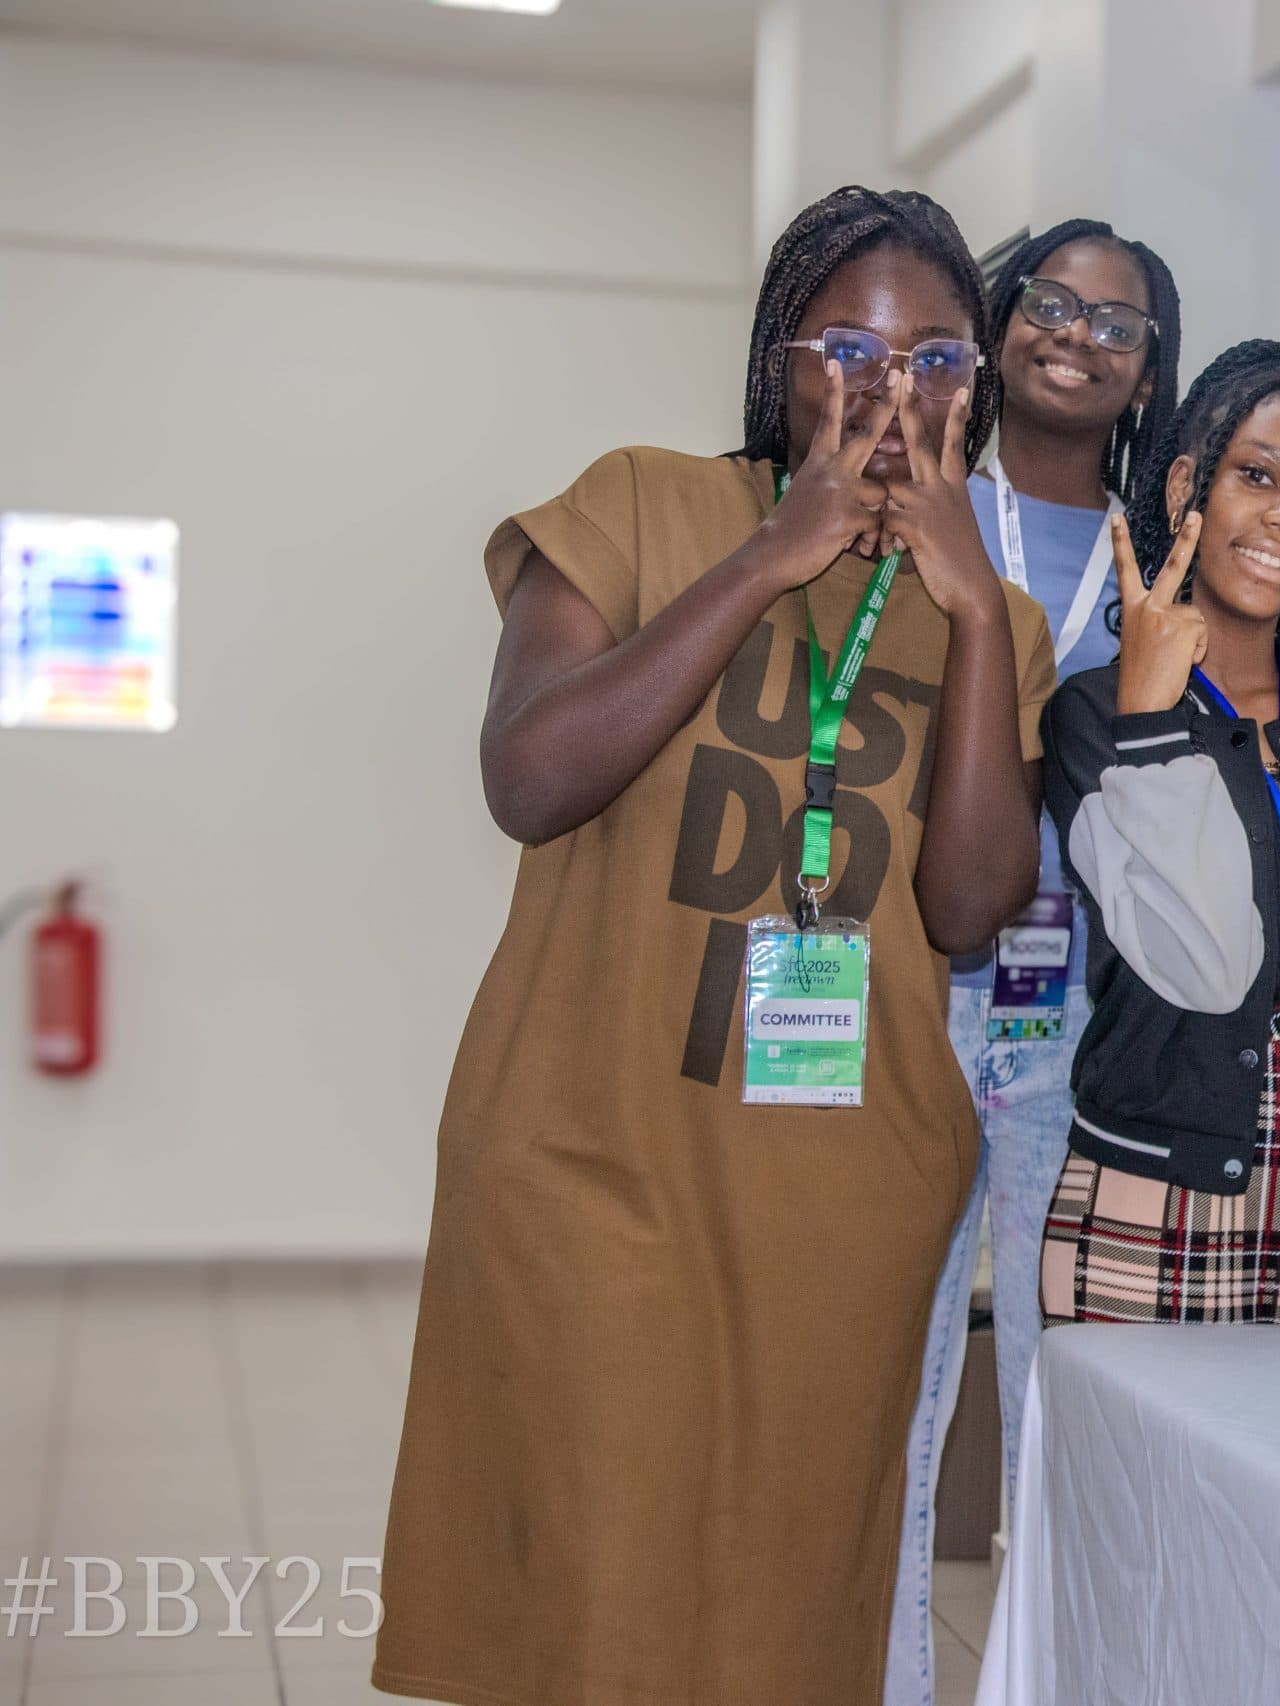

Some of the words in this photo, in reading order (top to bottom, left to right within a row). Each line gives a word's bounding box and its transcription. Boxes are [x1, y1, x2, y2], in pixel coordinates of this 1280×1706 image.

[690, 620, 941, 822] UST
[667, 743, 891, 925] DO
[680, 917, 746, 1088] I
[760, 1013, 852, 1027] COMMITTEE
